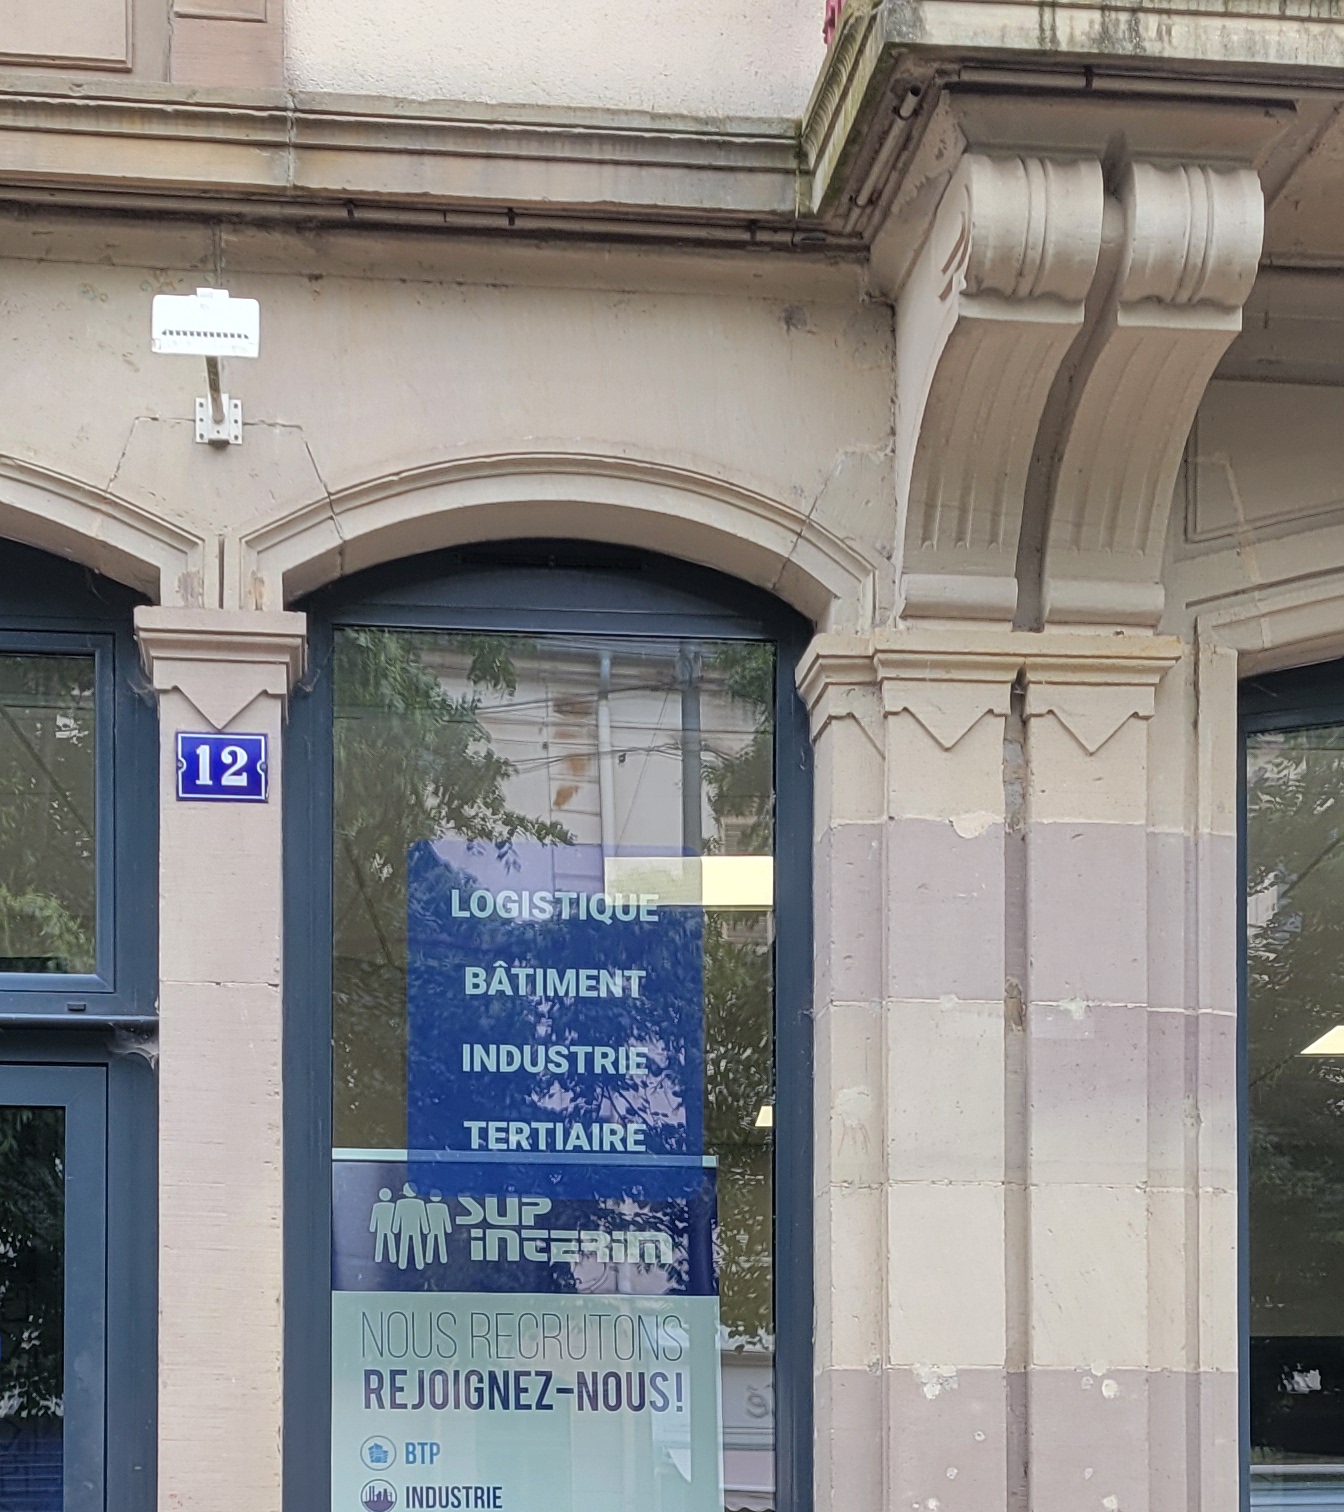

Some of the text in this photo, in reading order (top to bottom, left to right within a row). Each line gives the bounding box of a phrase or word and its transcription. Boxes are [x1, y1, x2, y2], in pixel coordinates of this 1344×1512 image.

[195, 744, 248, 787] 12
[450, 889, 660, 922] LOGISTIQUE
[464, 960, 646, 998] BÂTIMENT
[461, 1044, 649, 1075] INDUSTRIE
[463, 1120, 646, 1152] TERTIAIRE
[456, 1196, 552, 1227] SUP
[361, 1311, 684, 1362] NOUS RECRUTONS
[363, 1369, 684, 1413] REJOIGNEZ-NOUS!
[404, 1442, 441, 1466] BTP
[405, 1486, 503, 1510] INDUSTRIE
